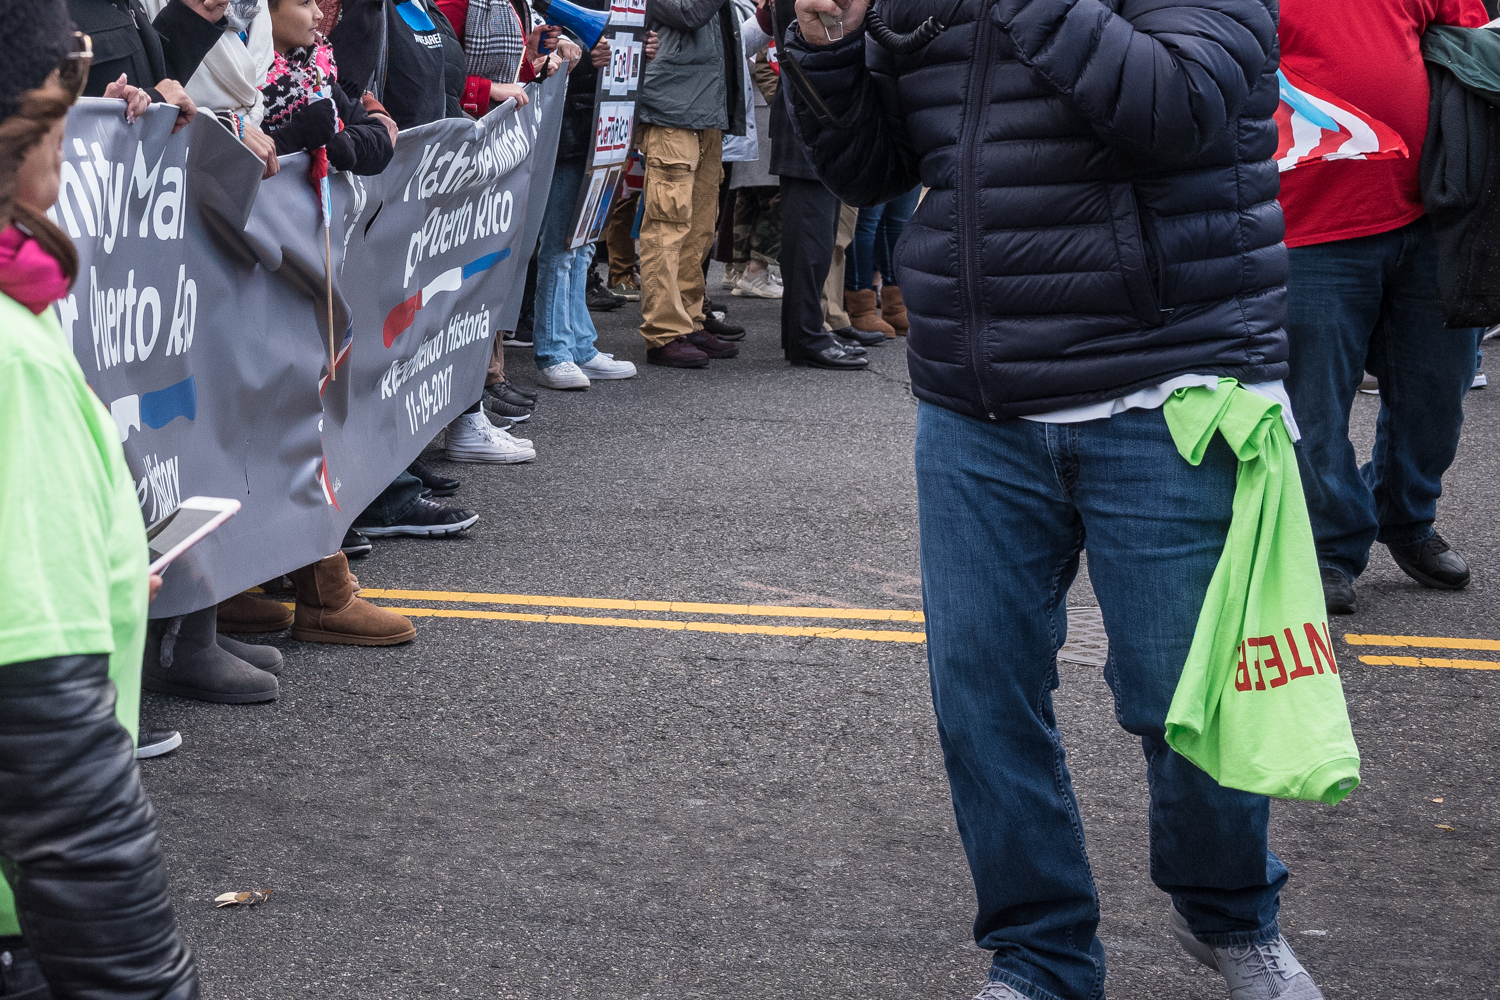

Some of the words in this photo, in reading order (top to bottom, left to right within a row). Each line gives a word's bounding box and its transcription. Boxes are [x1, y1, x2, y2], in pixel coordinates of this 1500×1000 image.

[473, 183, 514, 240] Rico
[89, 265, 161, 372] Puerto
[445, 303, 490, 355] Historia
[405, 363, 454, 436] 11-19-2017
